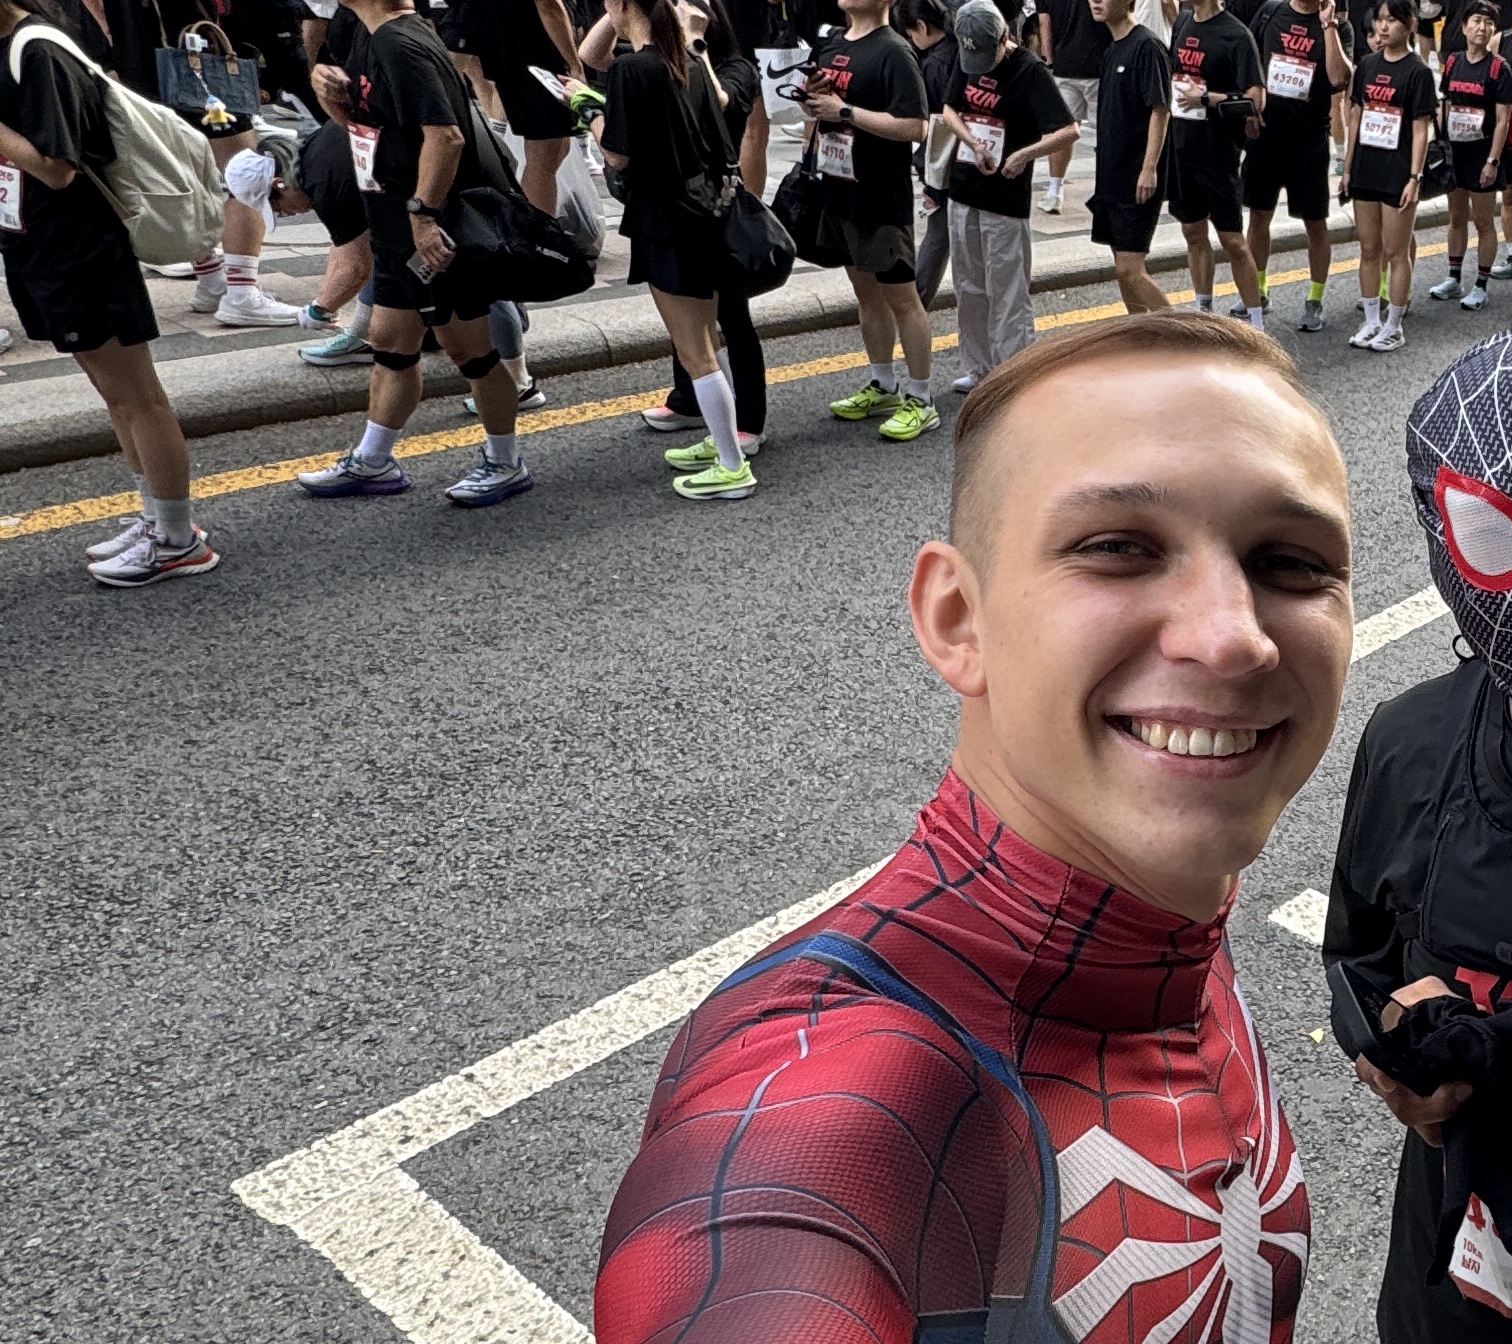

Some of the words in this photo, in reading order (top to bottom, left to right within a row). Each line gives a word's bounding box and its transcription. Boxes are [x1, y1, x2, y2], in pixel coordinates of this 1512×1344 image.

[1280, 32, 1316, 53] RUN
[1177, 47, 1205, 67] RUN
[964, 84, 1002, 110] RUN
[1365, 83, 1397, 102] RUN
